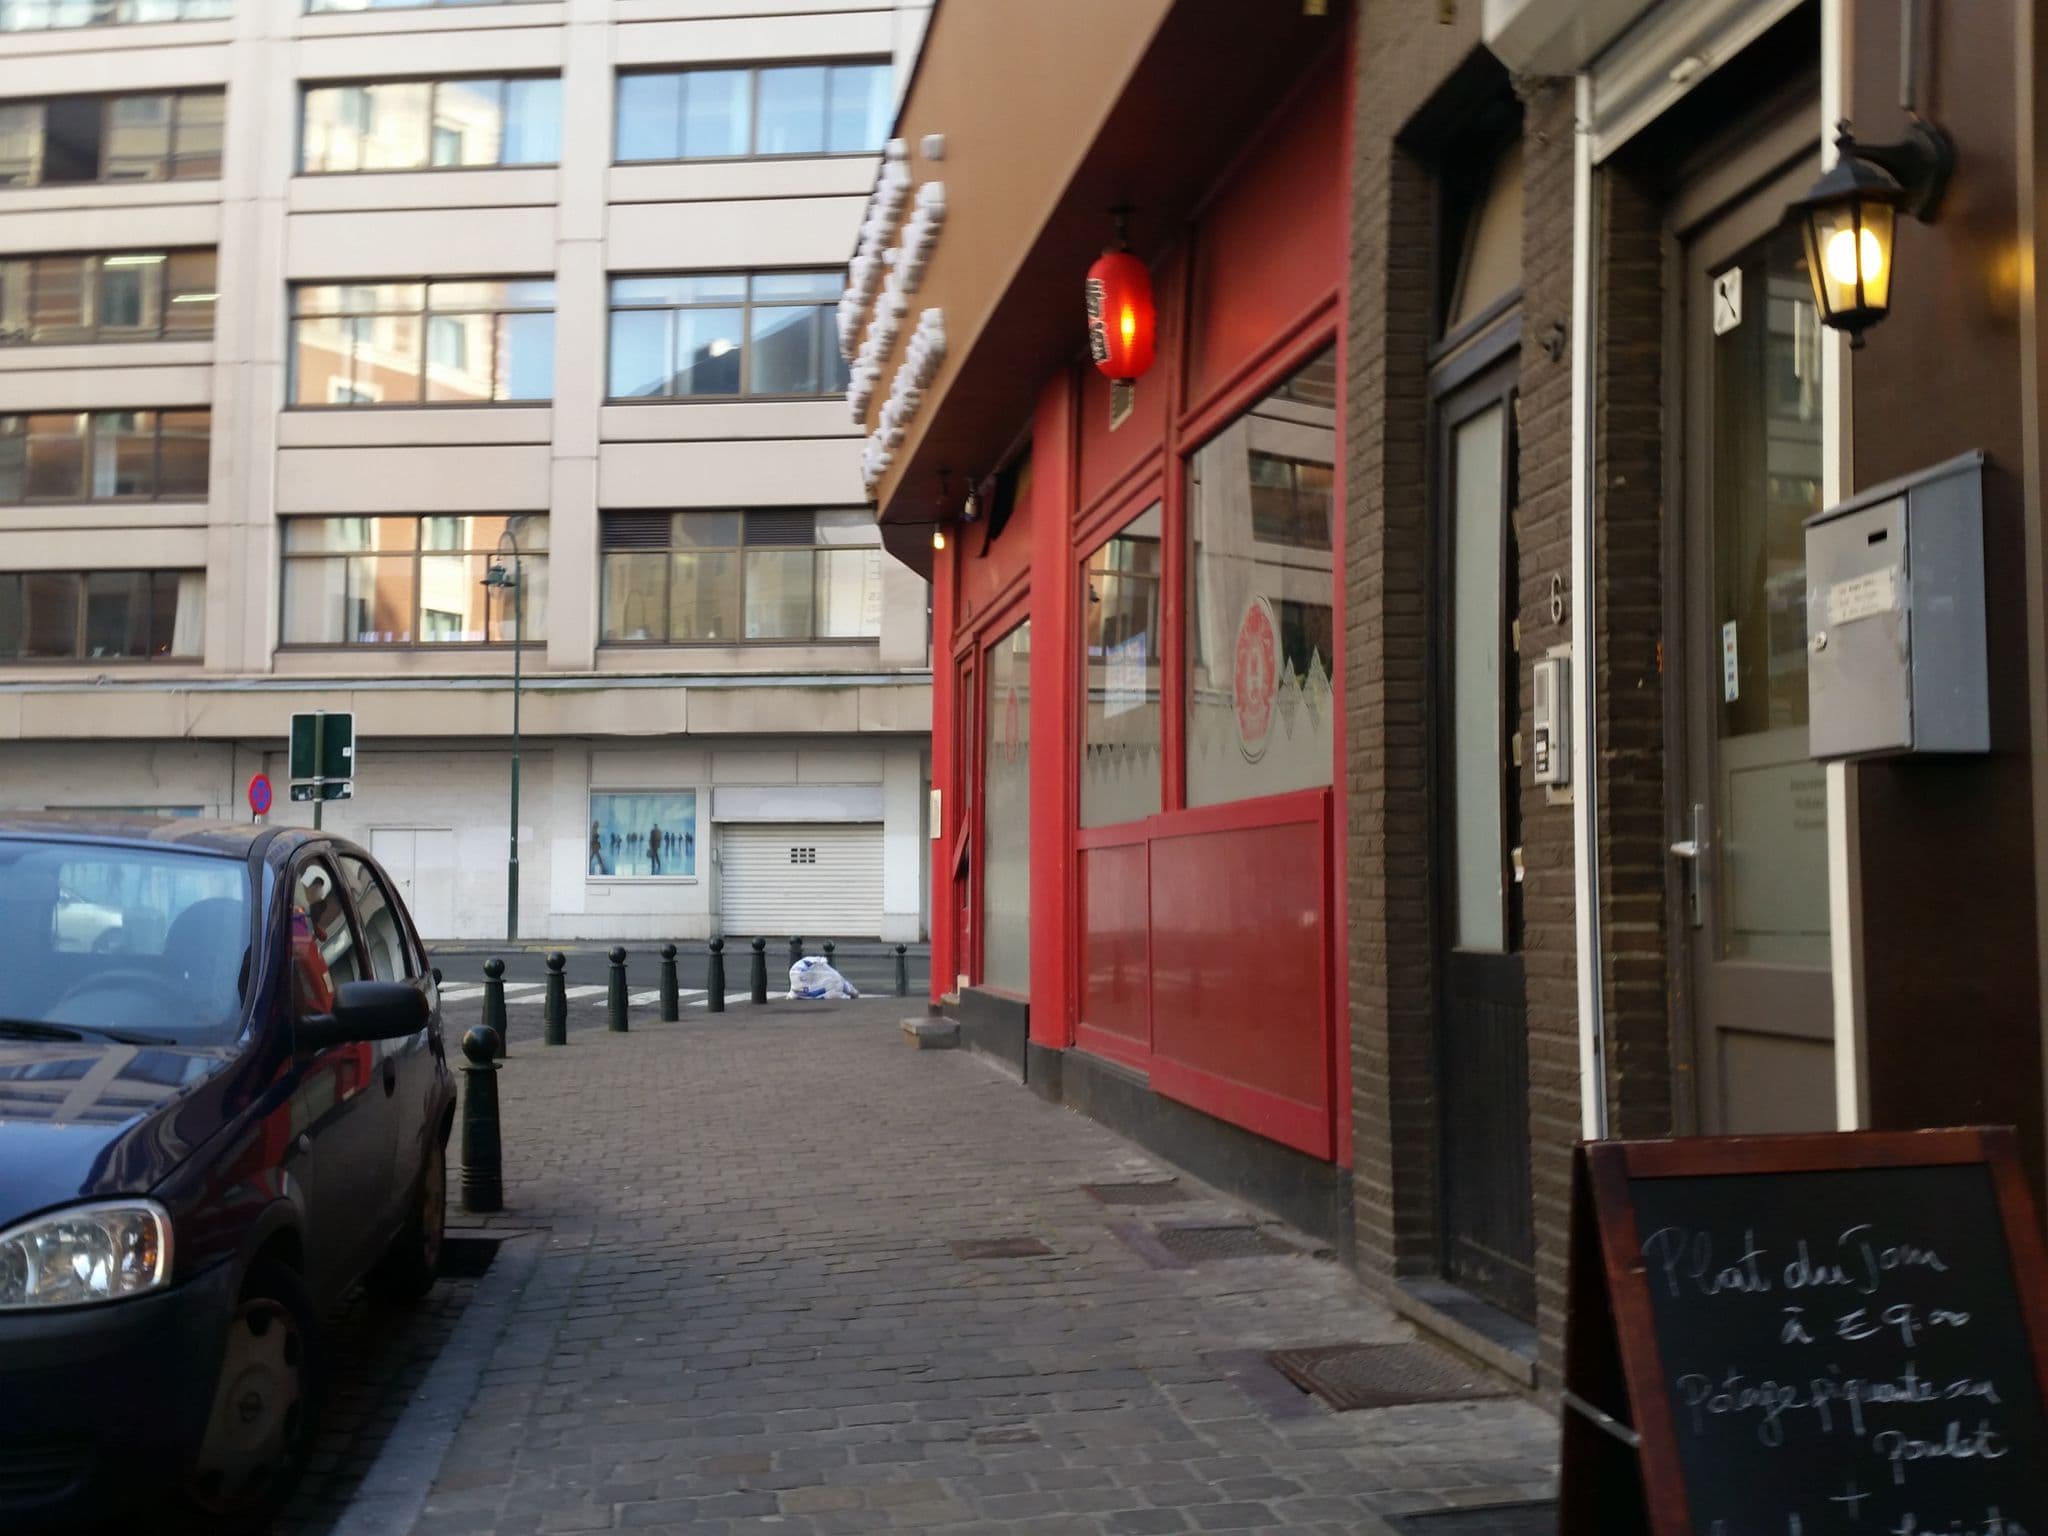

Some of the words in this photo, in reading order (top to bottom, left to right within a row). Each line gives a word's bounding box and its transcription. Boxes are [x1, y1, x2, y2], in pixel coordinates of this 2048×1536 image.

[1550, 572, 1562, 625] 6
[1640, 1225, 1772, 1297] Plat
[1783, 1239, 1854, 1290] du
